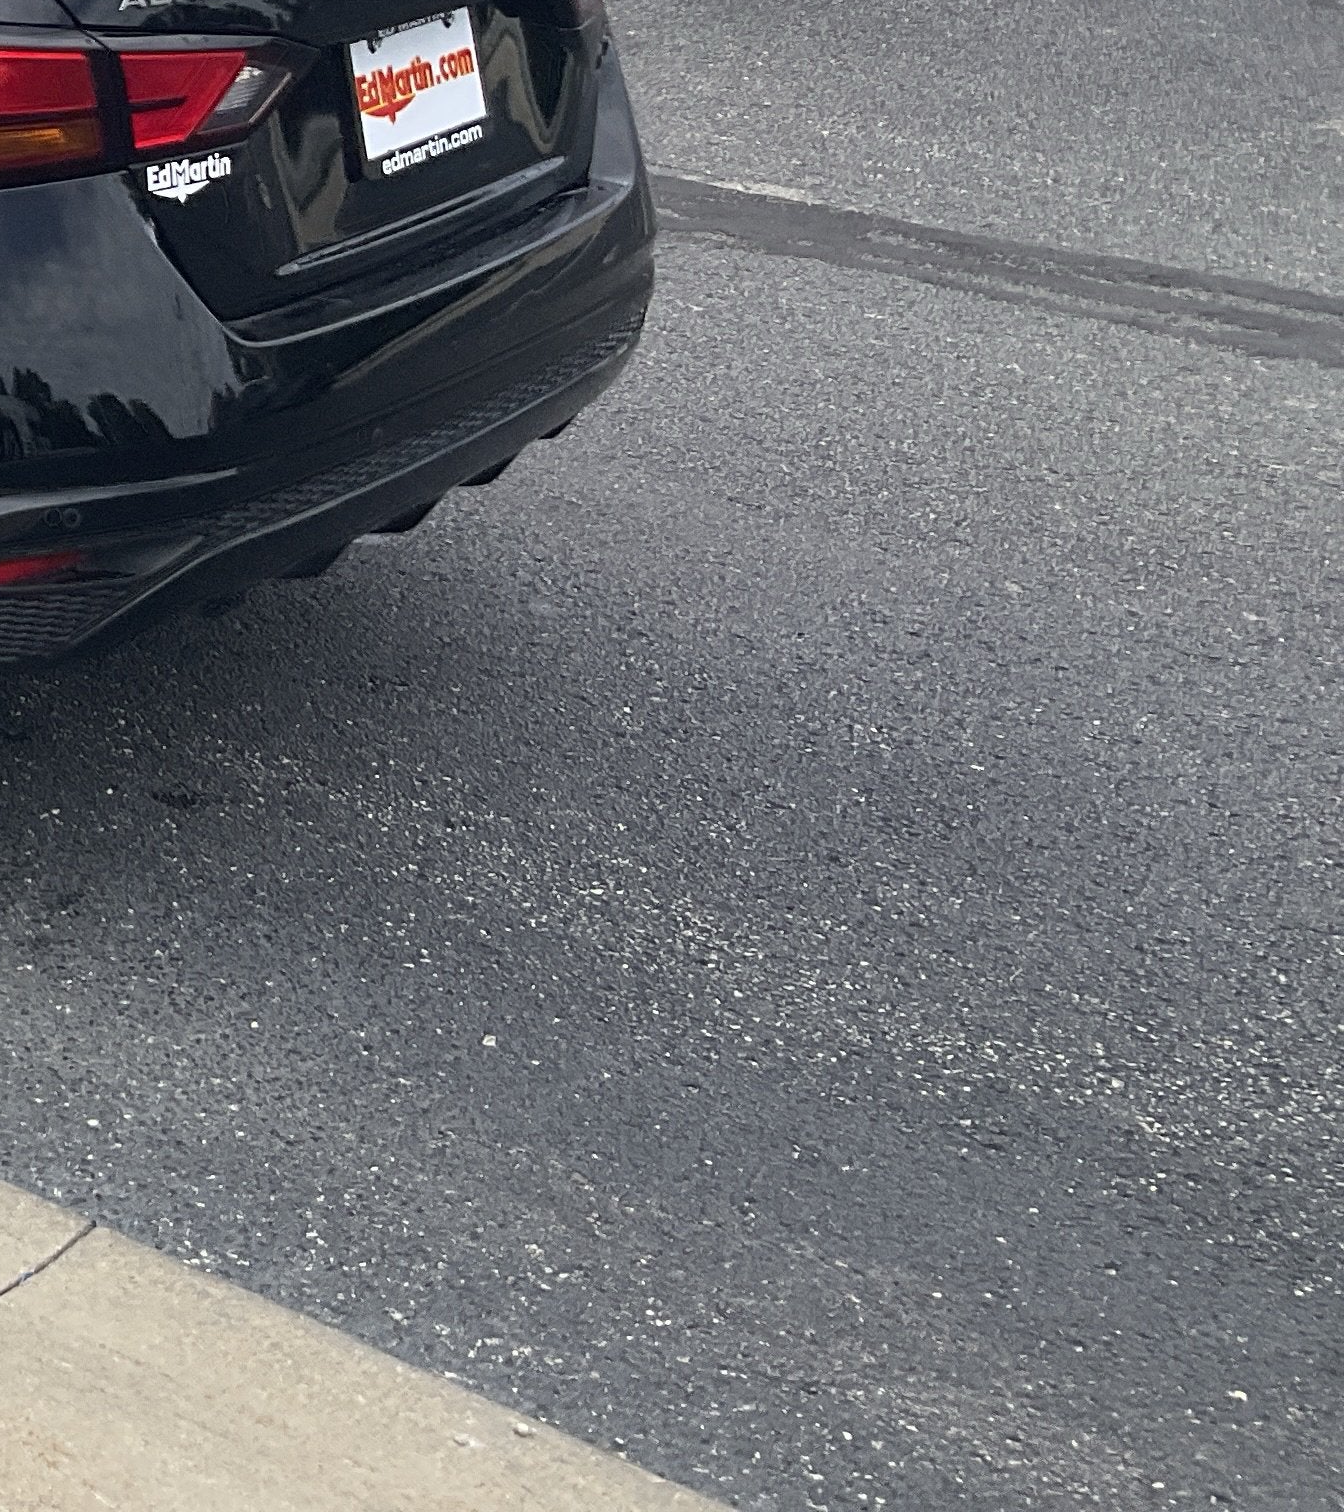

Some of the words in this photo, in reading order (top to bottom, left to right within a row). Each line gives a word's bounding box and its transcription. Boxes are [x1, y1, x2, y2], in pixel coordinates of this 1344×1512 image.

[355, 47, 475, 114] EdMartin.com
[146, 152, 231, 194] EdMartin
[382, 124, 483, 175] edmartin.com
